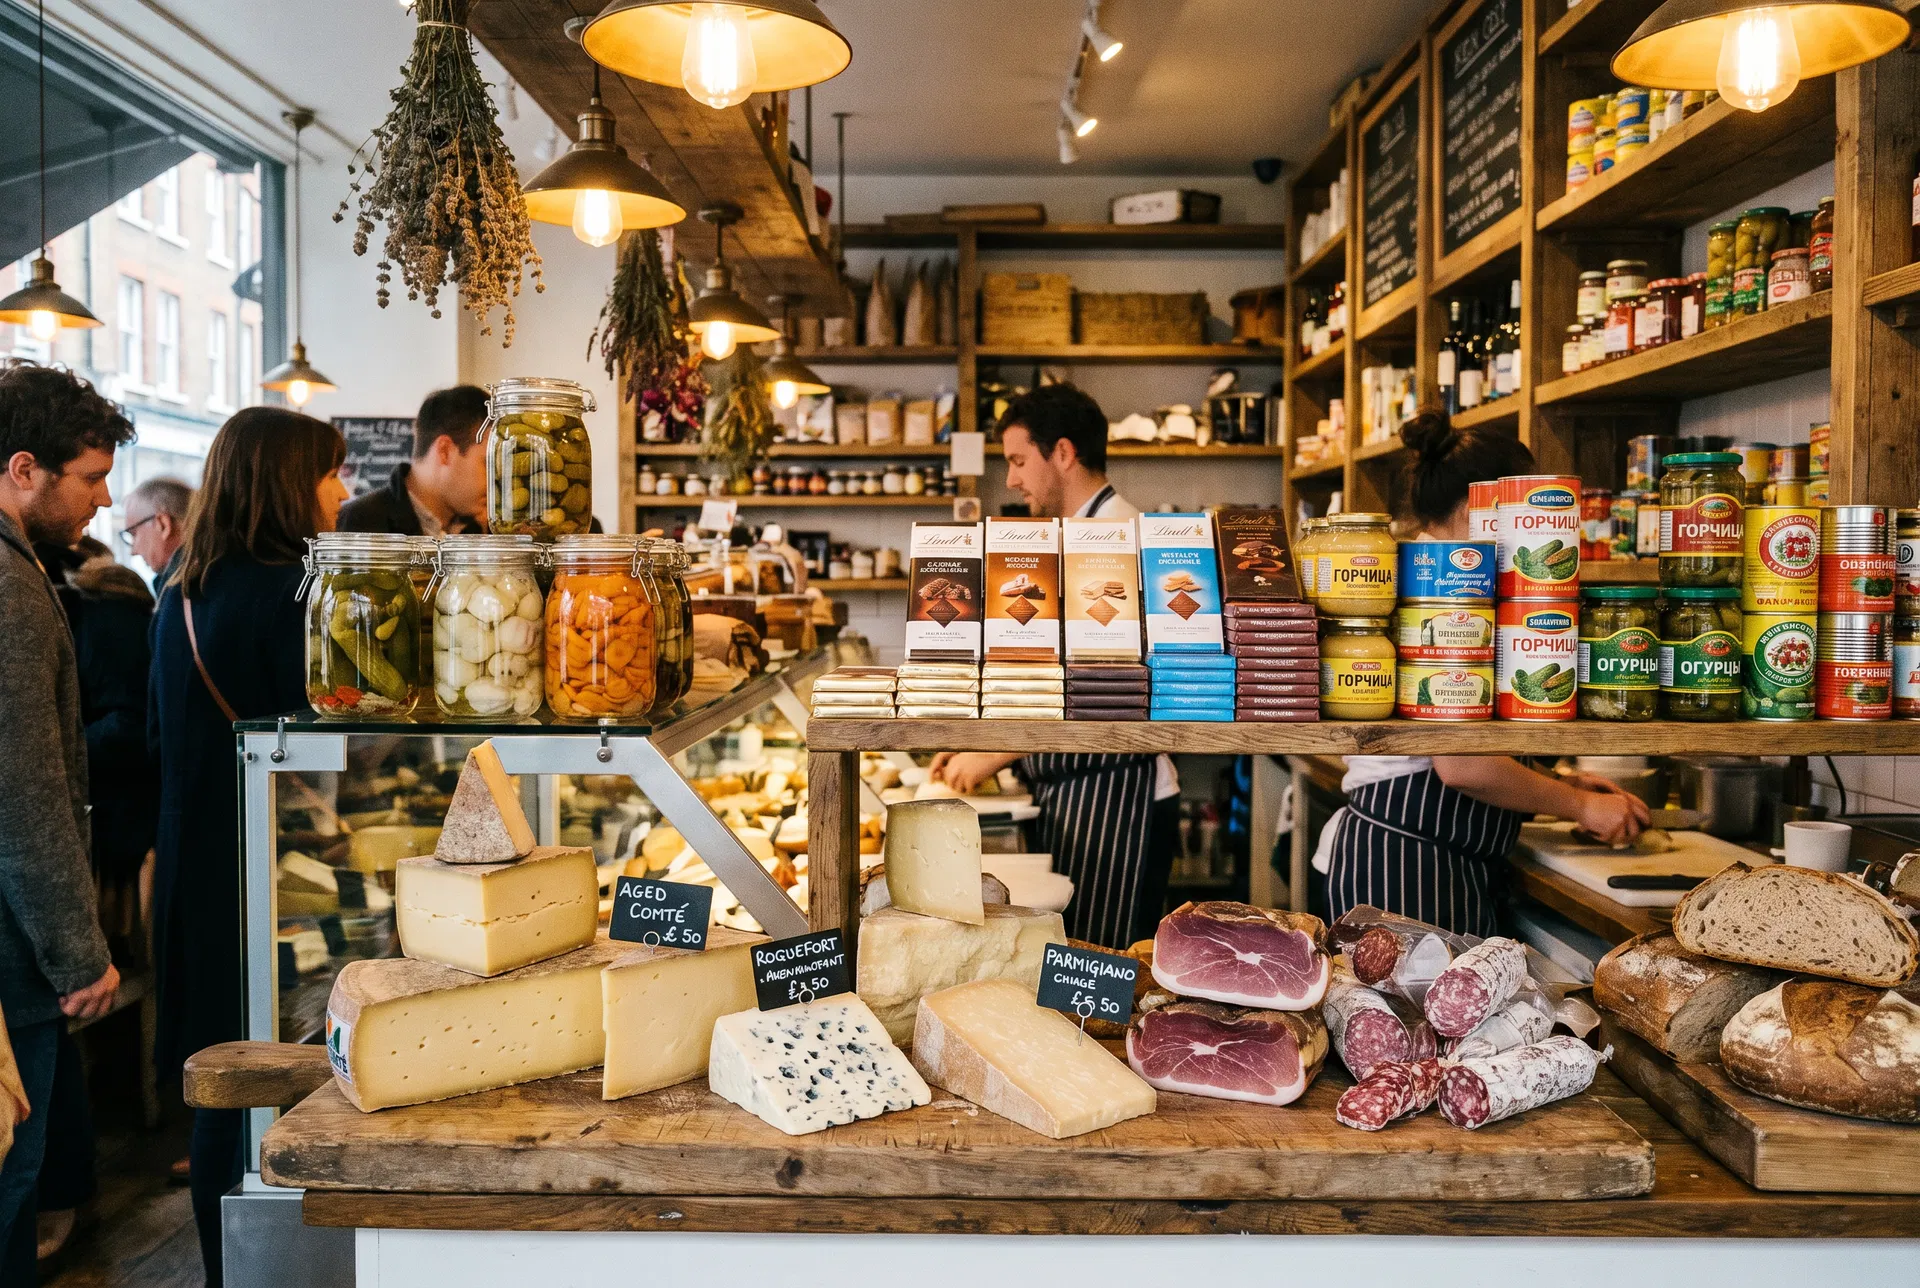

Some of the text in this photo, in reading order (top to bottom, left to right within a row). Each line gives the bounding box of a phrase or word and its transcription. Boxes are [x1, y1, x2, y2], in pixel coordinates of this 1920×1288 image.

[1150, 524, 1193, 537] Lindt
[1514, 515, 1580, 532] ГОРЧИЦА
[1678, 523, 1744, 540] ГОРЧИЦА
[919, 533, 963, 545] Lindt
[995, 528, 1038, 541] Lindt
[1075, 530, 1117, 542] Lindt
[1334, 569, 1392, 585] ГОРЧИЦА
[1597, 657, 1658, 674] ОГУРЦЫ
[1680, 660, 1741, 677] ОГУРЦЫ
[1338, 674, 1393, 689] ГОРЧИЦА
[619, 882, 667, 901] AGED
[629, 902, 690, 924] COMTÉ
[1053, 972, 1096, 990] CHIAGE
